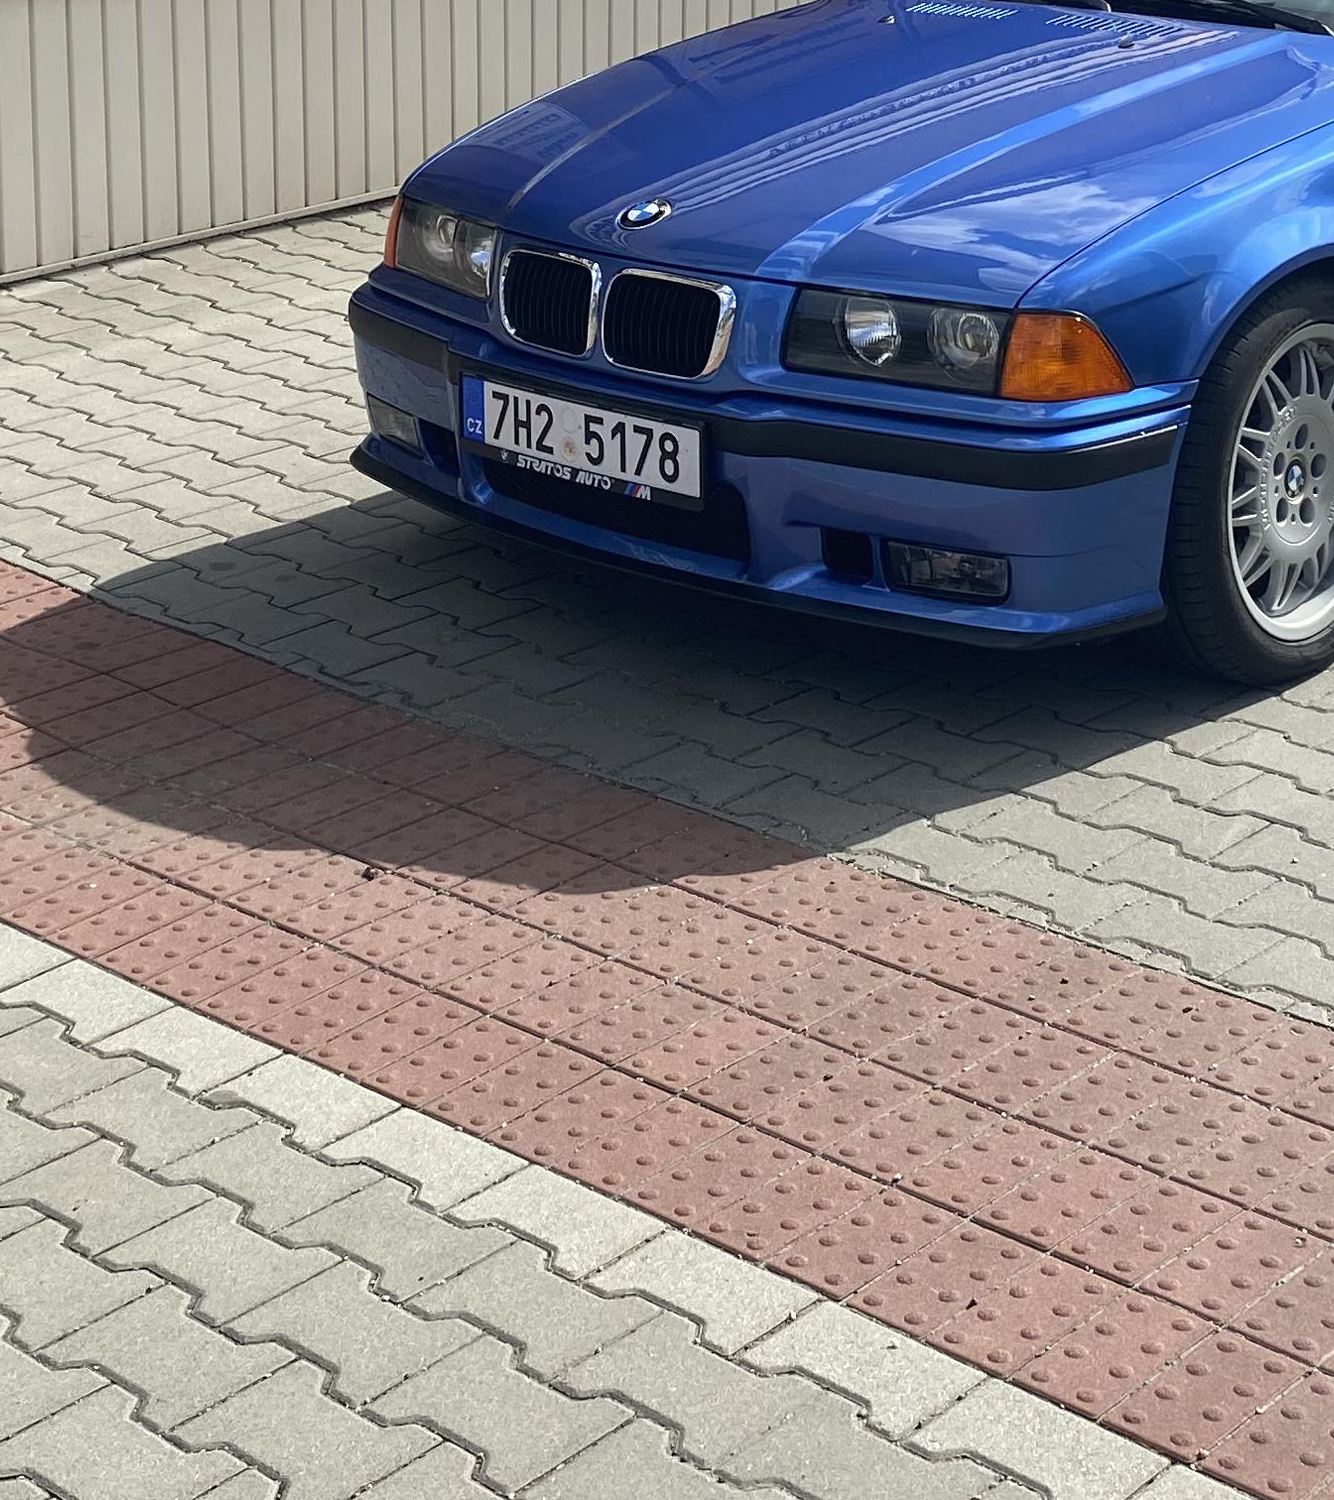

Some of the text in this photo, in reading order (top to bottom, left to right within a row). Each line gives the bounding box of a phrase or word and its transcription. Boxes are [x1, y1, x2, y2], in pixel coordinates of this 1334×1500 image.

[467, 389, 680, 484] CZ 7H2 5178
[516, 454, 611, 490] STRATOS AUTO
